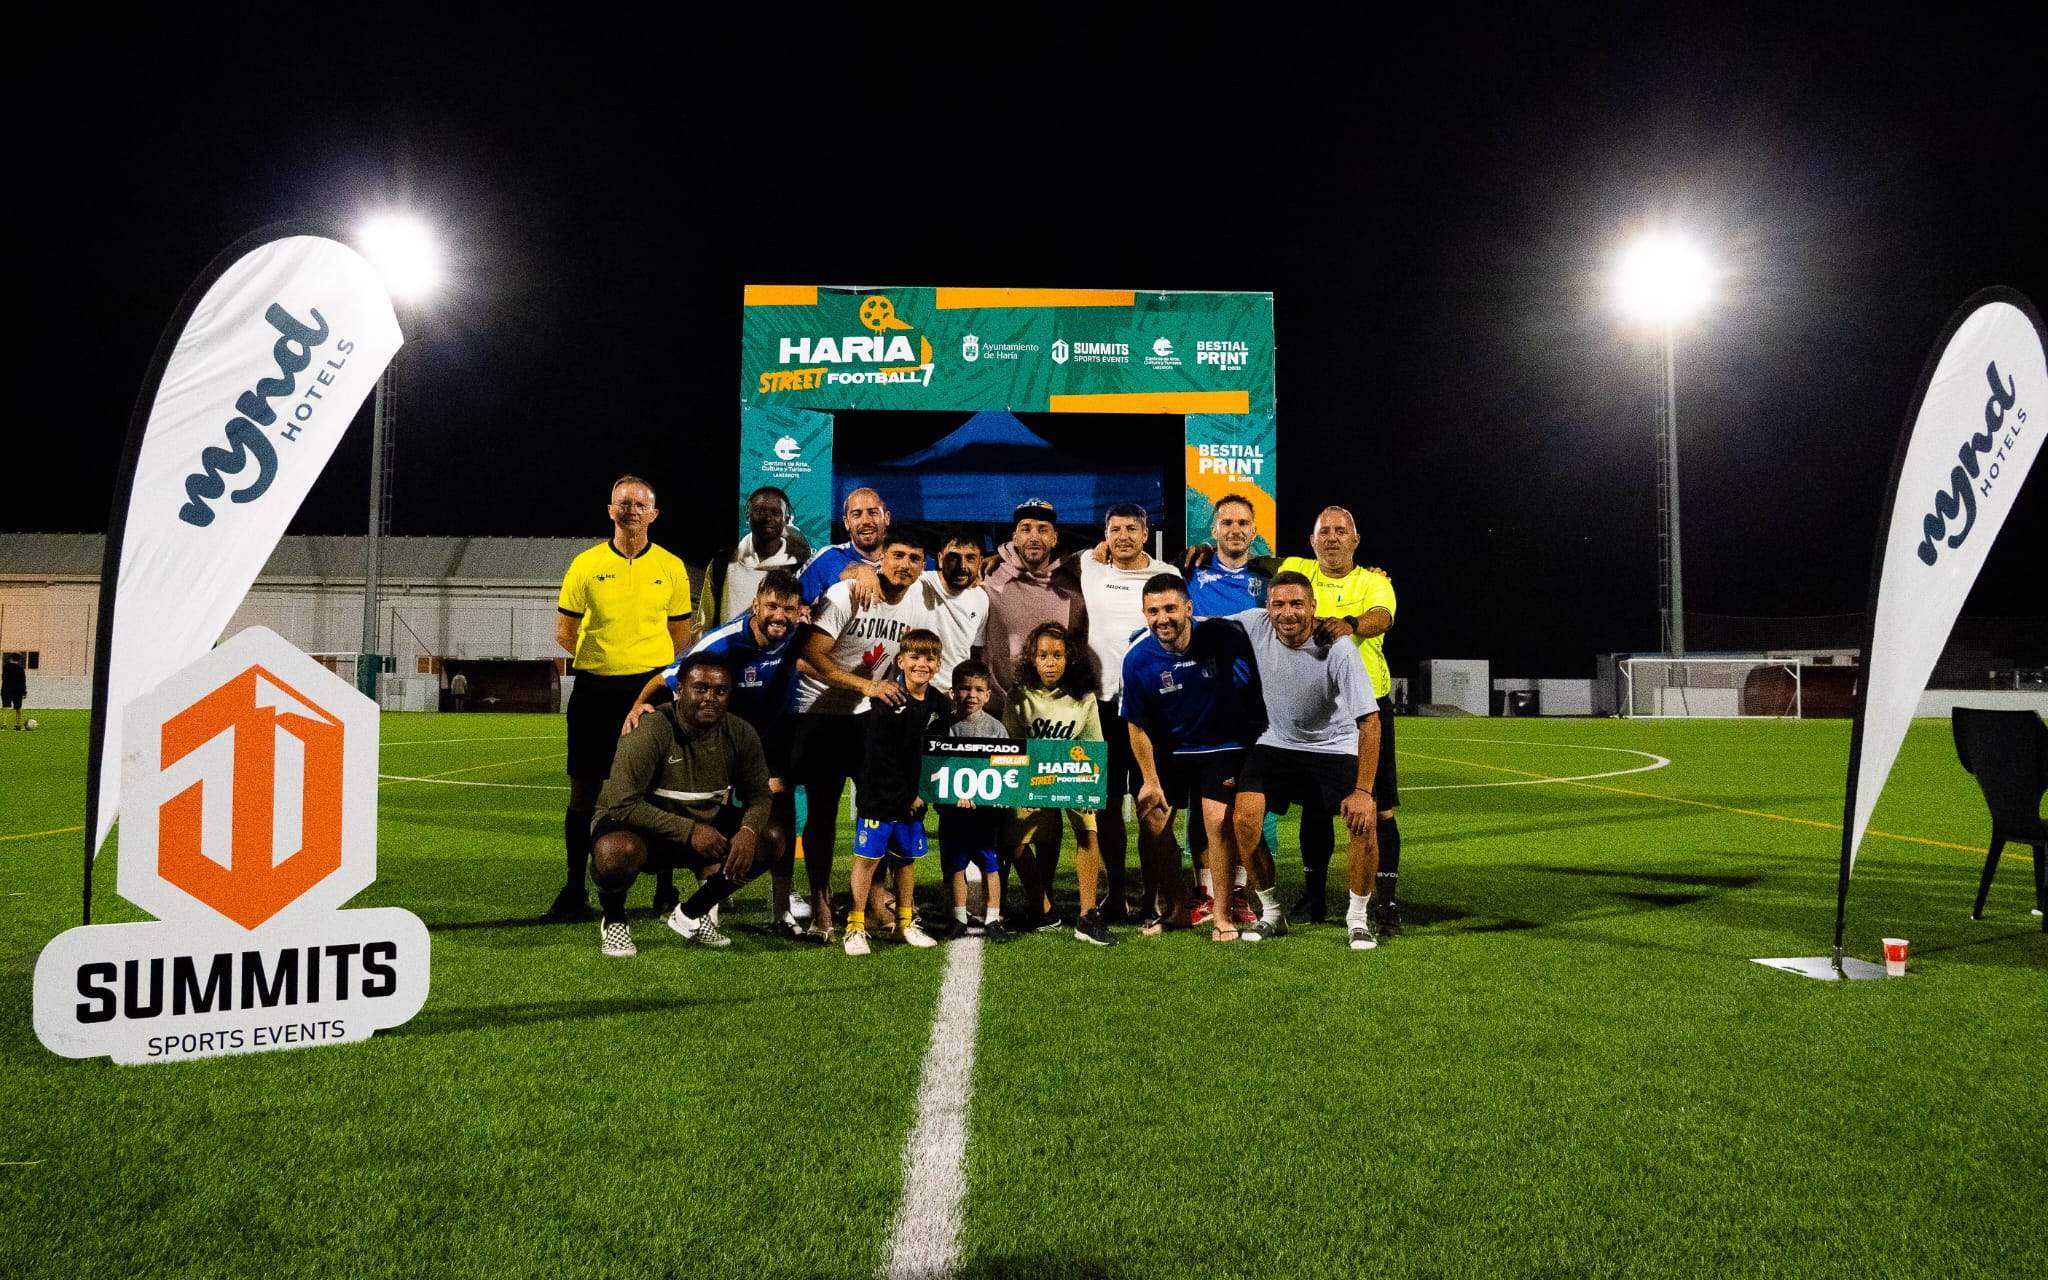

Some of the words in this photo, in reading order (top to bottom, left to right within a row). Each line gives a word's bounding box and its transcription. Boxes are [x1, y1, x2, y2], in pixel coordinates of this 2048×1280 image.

[779, 335, 915, 363] HARIA
[982, 342, 1040, 352] Ayuntamiento
[1074, 342, 1129, 355] SUMMITS
[1197, 341, 1248, 351] BESTIAL
[984, 351, 995, 360] de
[1074, 355, 1101, 363] SPORTS
[1102, 356, 1129, 364] EVENTS
[759, 368, 828, 394] STREET
[280, 338, 354, 442] HOTELS
[179, 302, 329, 527] mynd
[1199, 444, 1264, 457] BESTIAL
[1980, 408, 2027, 498] HOTELS
[1917, 360, 2016, 567] mynd
[940, 743, 1020, 753] CLASIFICADO
[1038, 762, 1093, 774] HARIA
[1030, 774, 1057, 786] STREET
[76, 941, 397, 1024] SUMMITS
[148, 1030, 245, 1056] SPORTS
[254, 1020, 346, 1046] EVENTS
